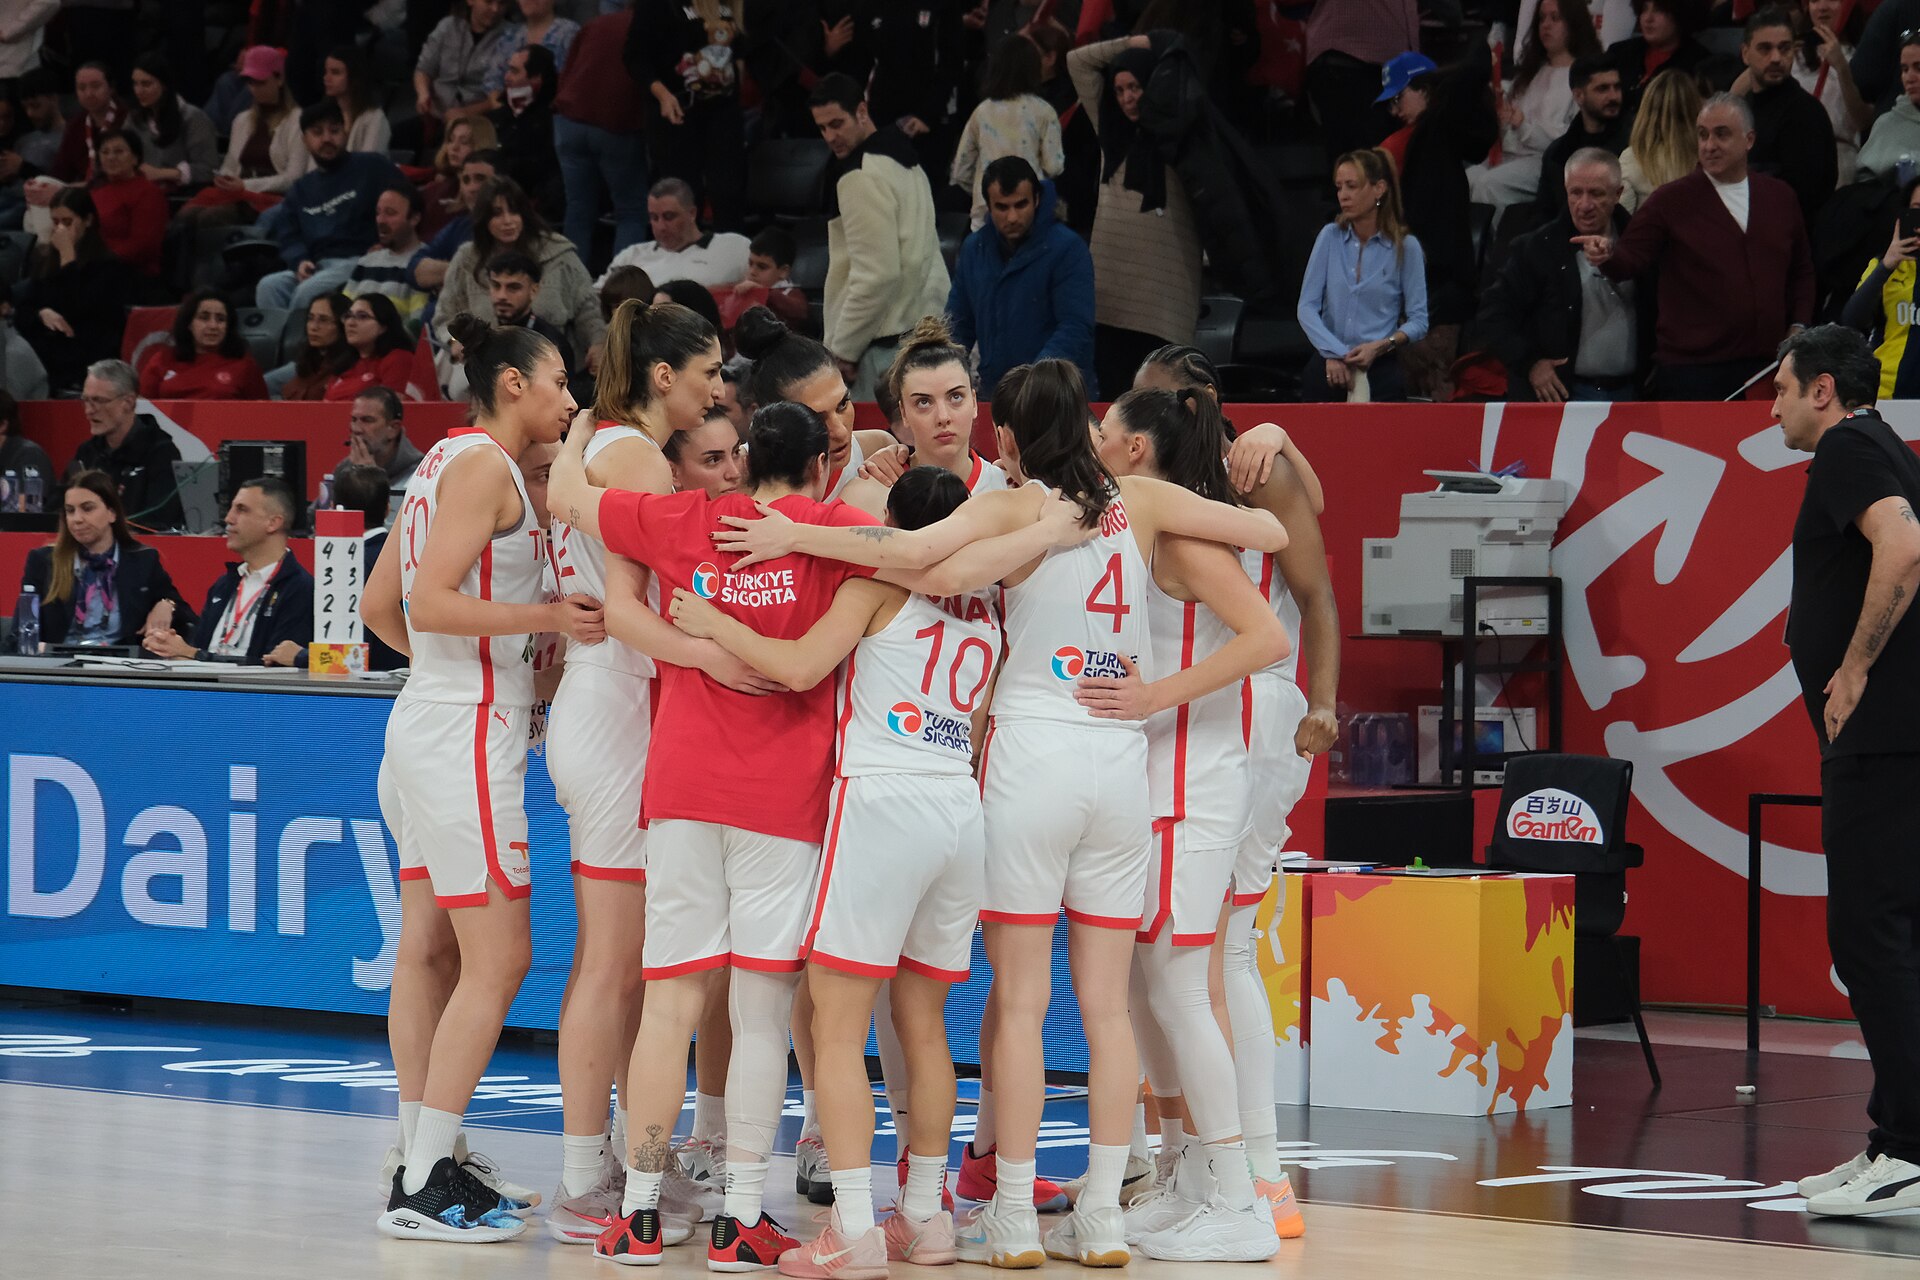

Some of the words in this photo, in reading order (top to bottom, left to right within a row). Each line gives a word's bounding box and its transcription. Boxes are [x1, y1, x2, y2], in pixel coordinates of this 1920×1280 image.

[322, 541, 334, 560] 4
[348, 541, 357, 560] 4
[322, 567, 334, 586] 3
[348, 567, 357, 586] 3
[322, 594, 334, 613] 2
[348, 594, 357, 613] 2
[1086, 553, 1130, 633] 4
[322, 620, 334, 639] 1
[348, 620, 357, 639] 1
[915, 619, 993, 713] 10
[1526, 795, 1582, 816] 百岁山
[1513, 811, 1597, 841] Ganten
[7, 753, 402, 991] Dairy
